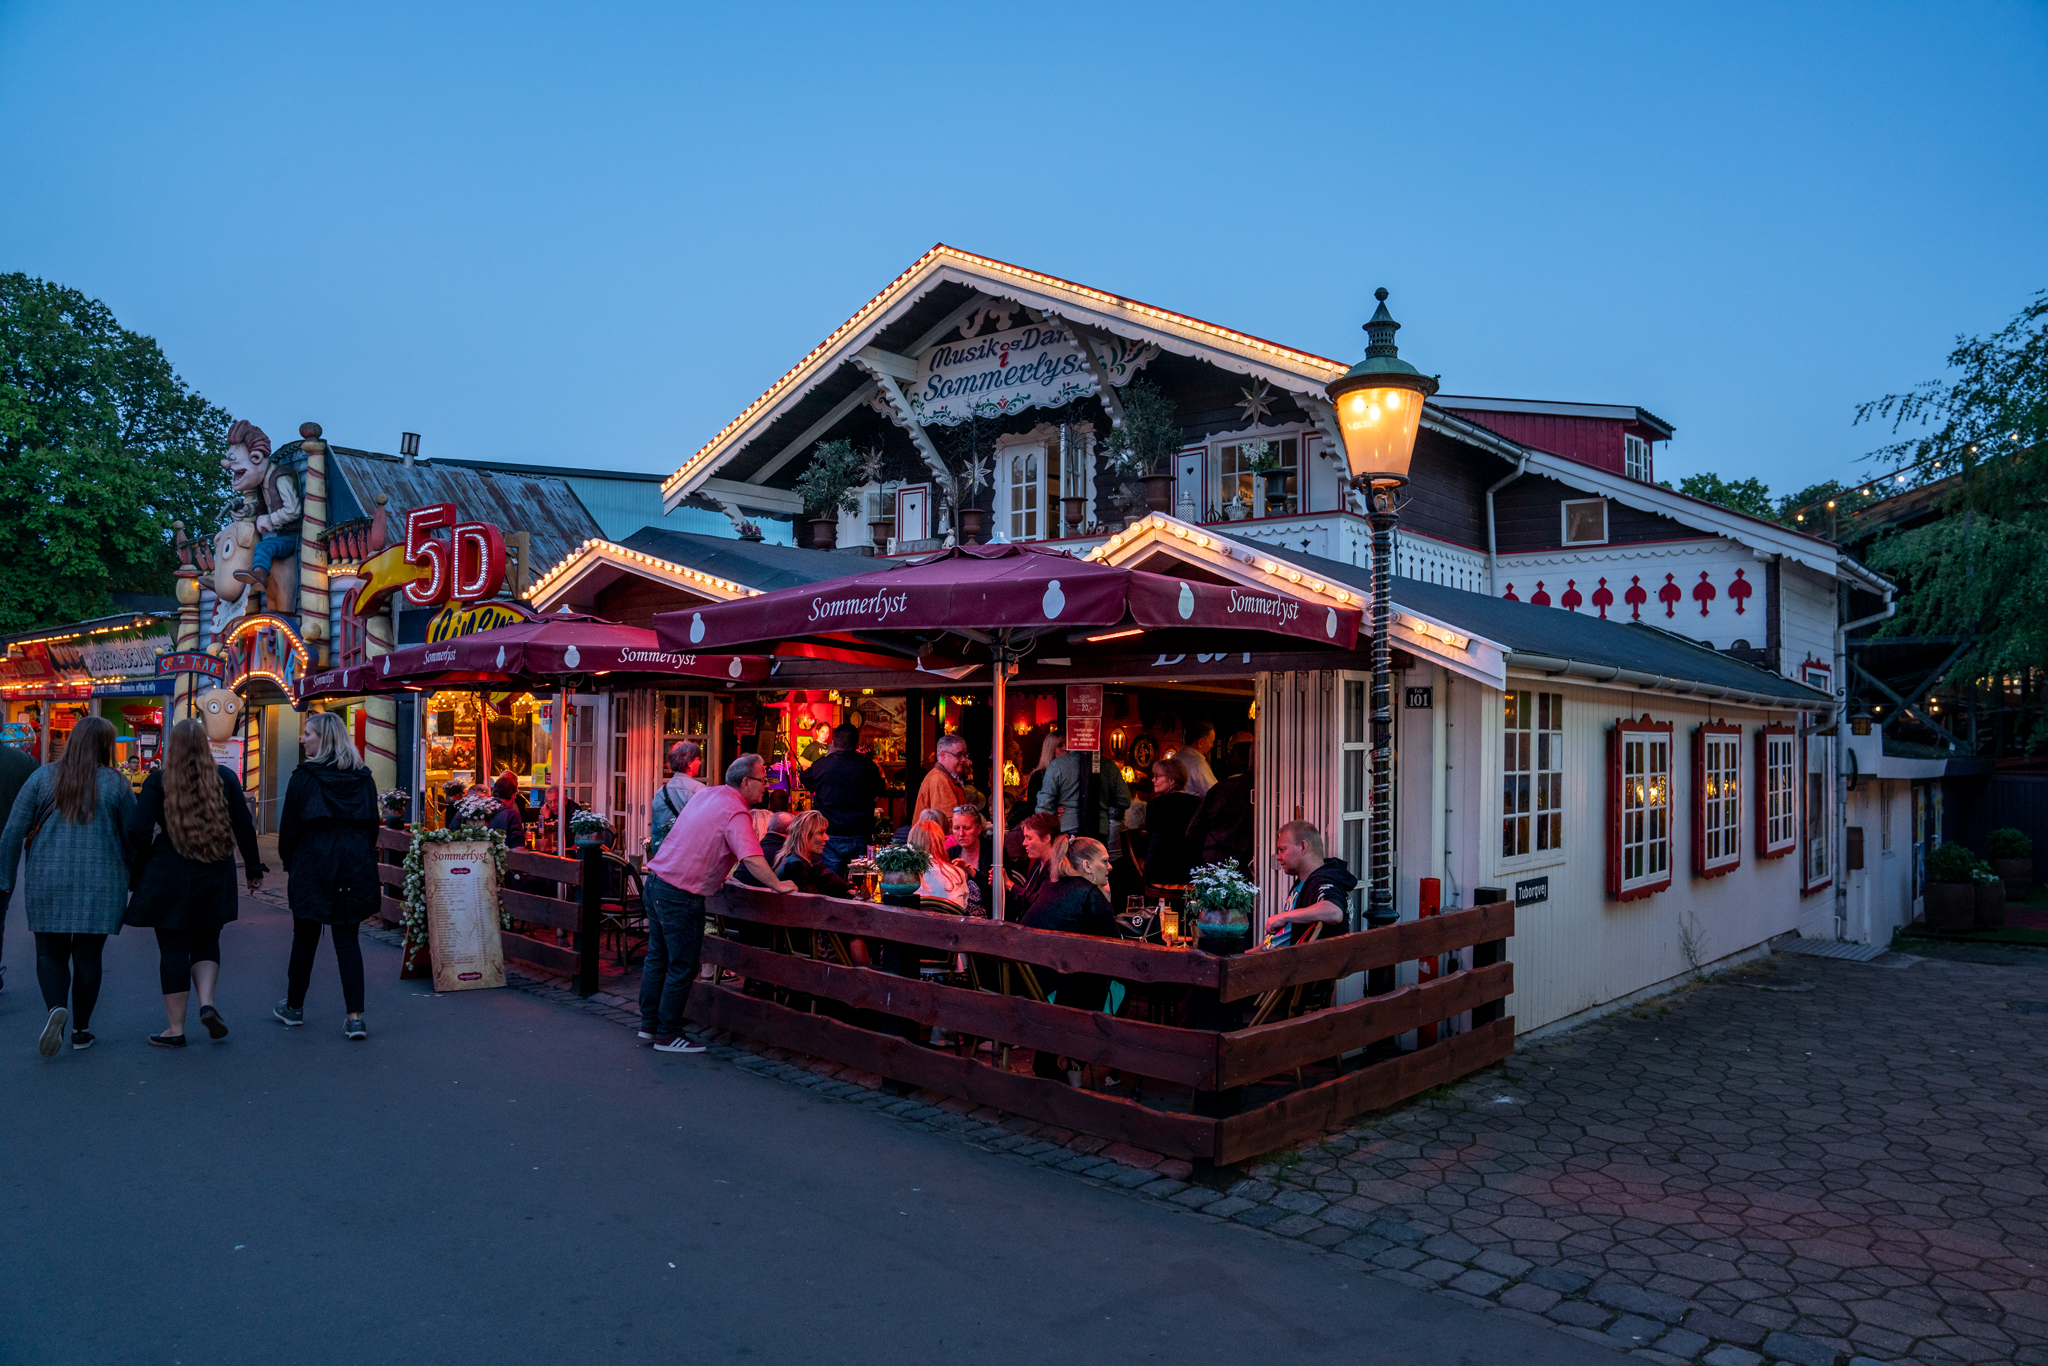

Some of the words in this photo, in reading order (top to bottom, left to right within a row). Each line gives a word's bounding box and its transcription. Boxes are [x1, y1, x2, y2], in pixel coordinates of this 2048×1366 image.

[929, 337, 1000, 373] Musik
[1020, 327, 1071, 352] Dan
[923, 351, 1085, 402] Sommerlys
[403, 503, 506, 606] 5D
[808, 588, 908, 622] Sommerlyst
[1227, 588, 1299, 626] Sommerlyst
[432, 607, 514, 644] Cinem
[161, 655, 188, 671] CRAZ
[423, 646, 456, 666] Sommerlyst
[618, 647, 697, 669] Sommerlyst
[1409, 693, 1429, 707] 101
[431, 849, 488, 864] Sommerlyst
[1518, 884, 1547, 901] Tuborgvej
